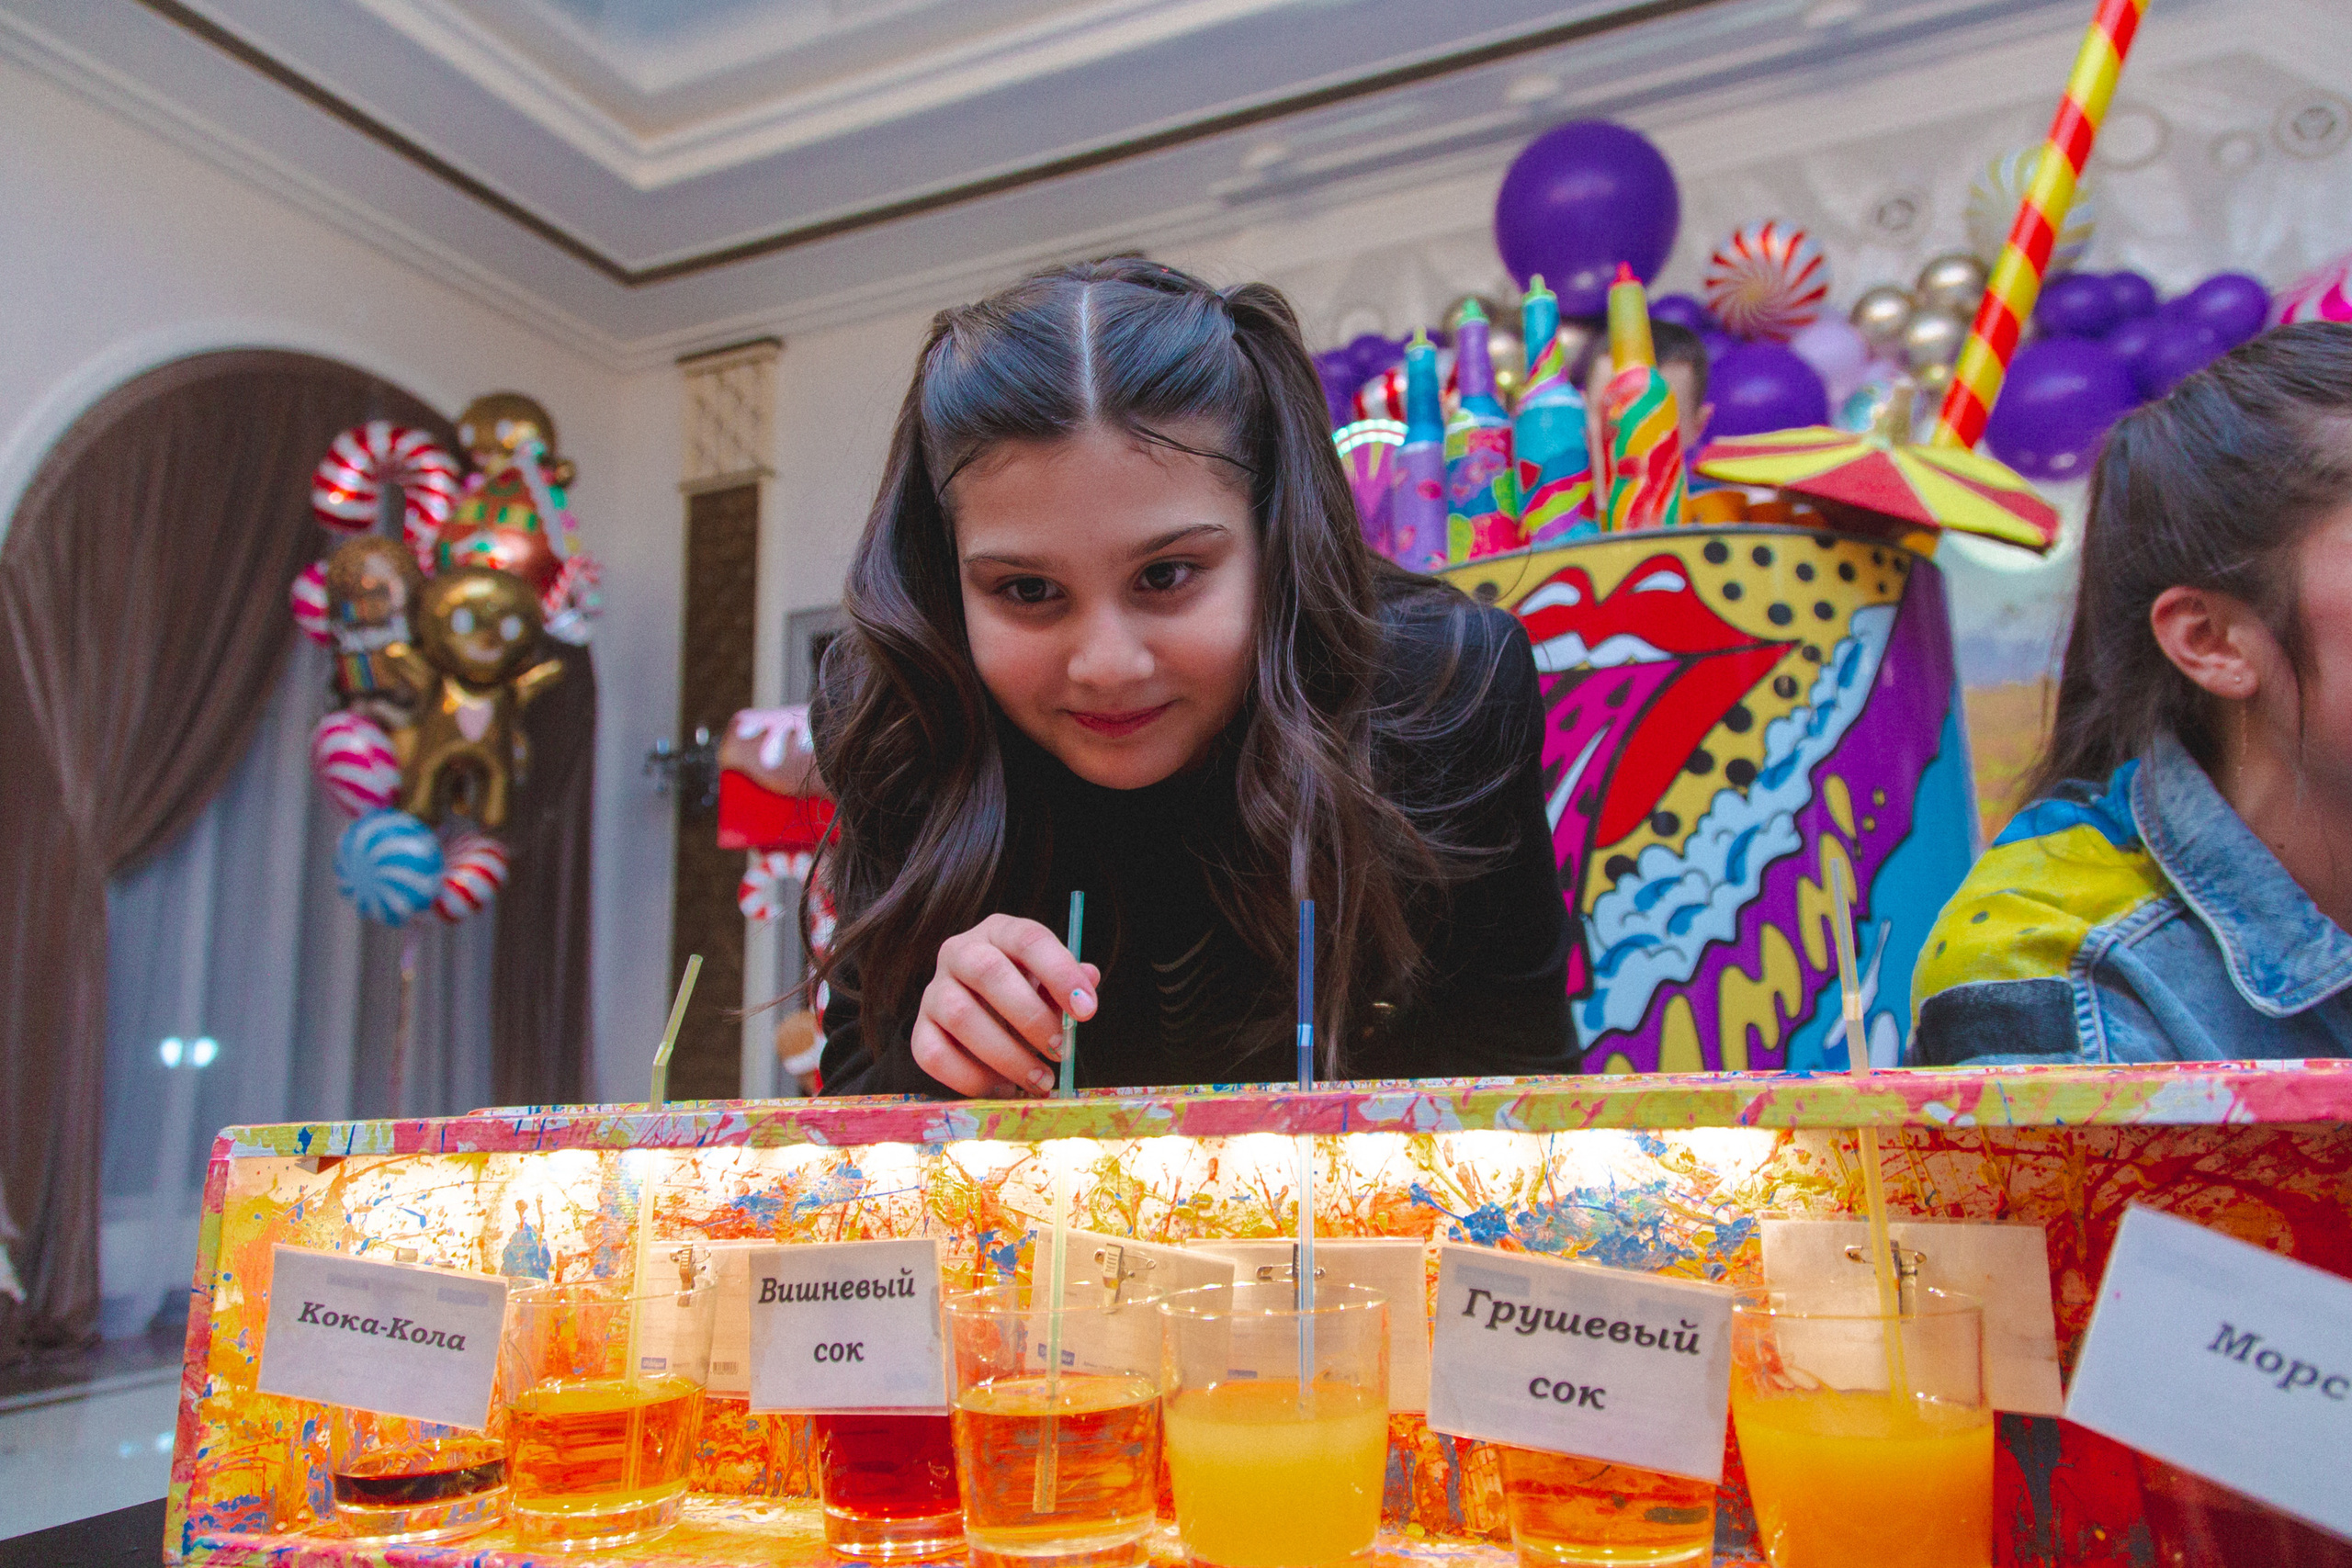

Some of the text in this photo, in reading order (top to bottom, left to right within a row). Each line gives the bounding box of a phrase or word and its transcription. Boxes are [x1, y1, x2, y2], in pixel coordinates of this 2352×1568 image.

[758, 1267, 916, 1304] Вишневый
[297, 1301, 467, 1352] Кока-Кола
[1462, 1288, 1701, 1355] Грушевый
[813, 1341, 865, 1363] сок
[2207, 1322, 2351, 1401] Морс
[1529, 1377, 1606, 1410] сок
